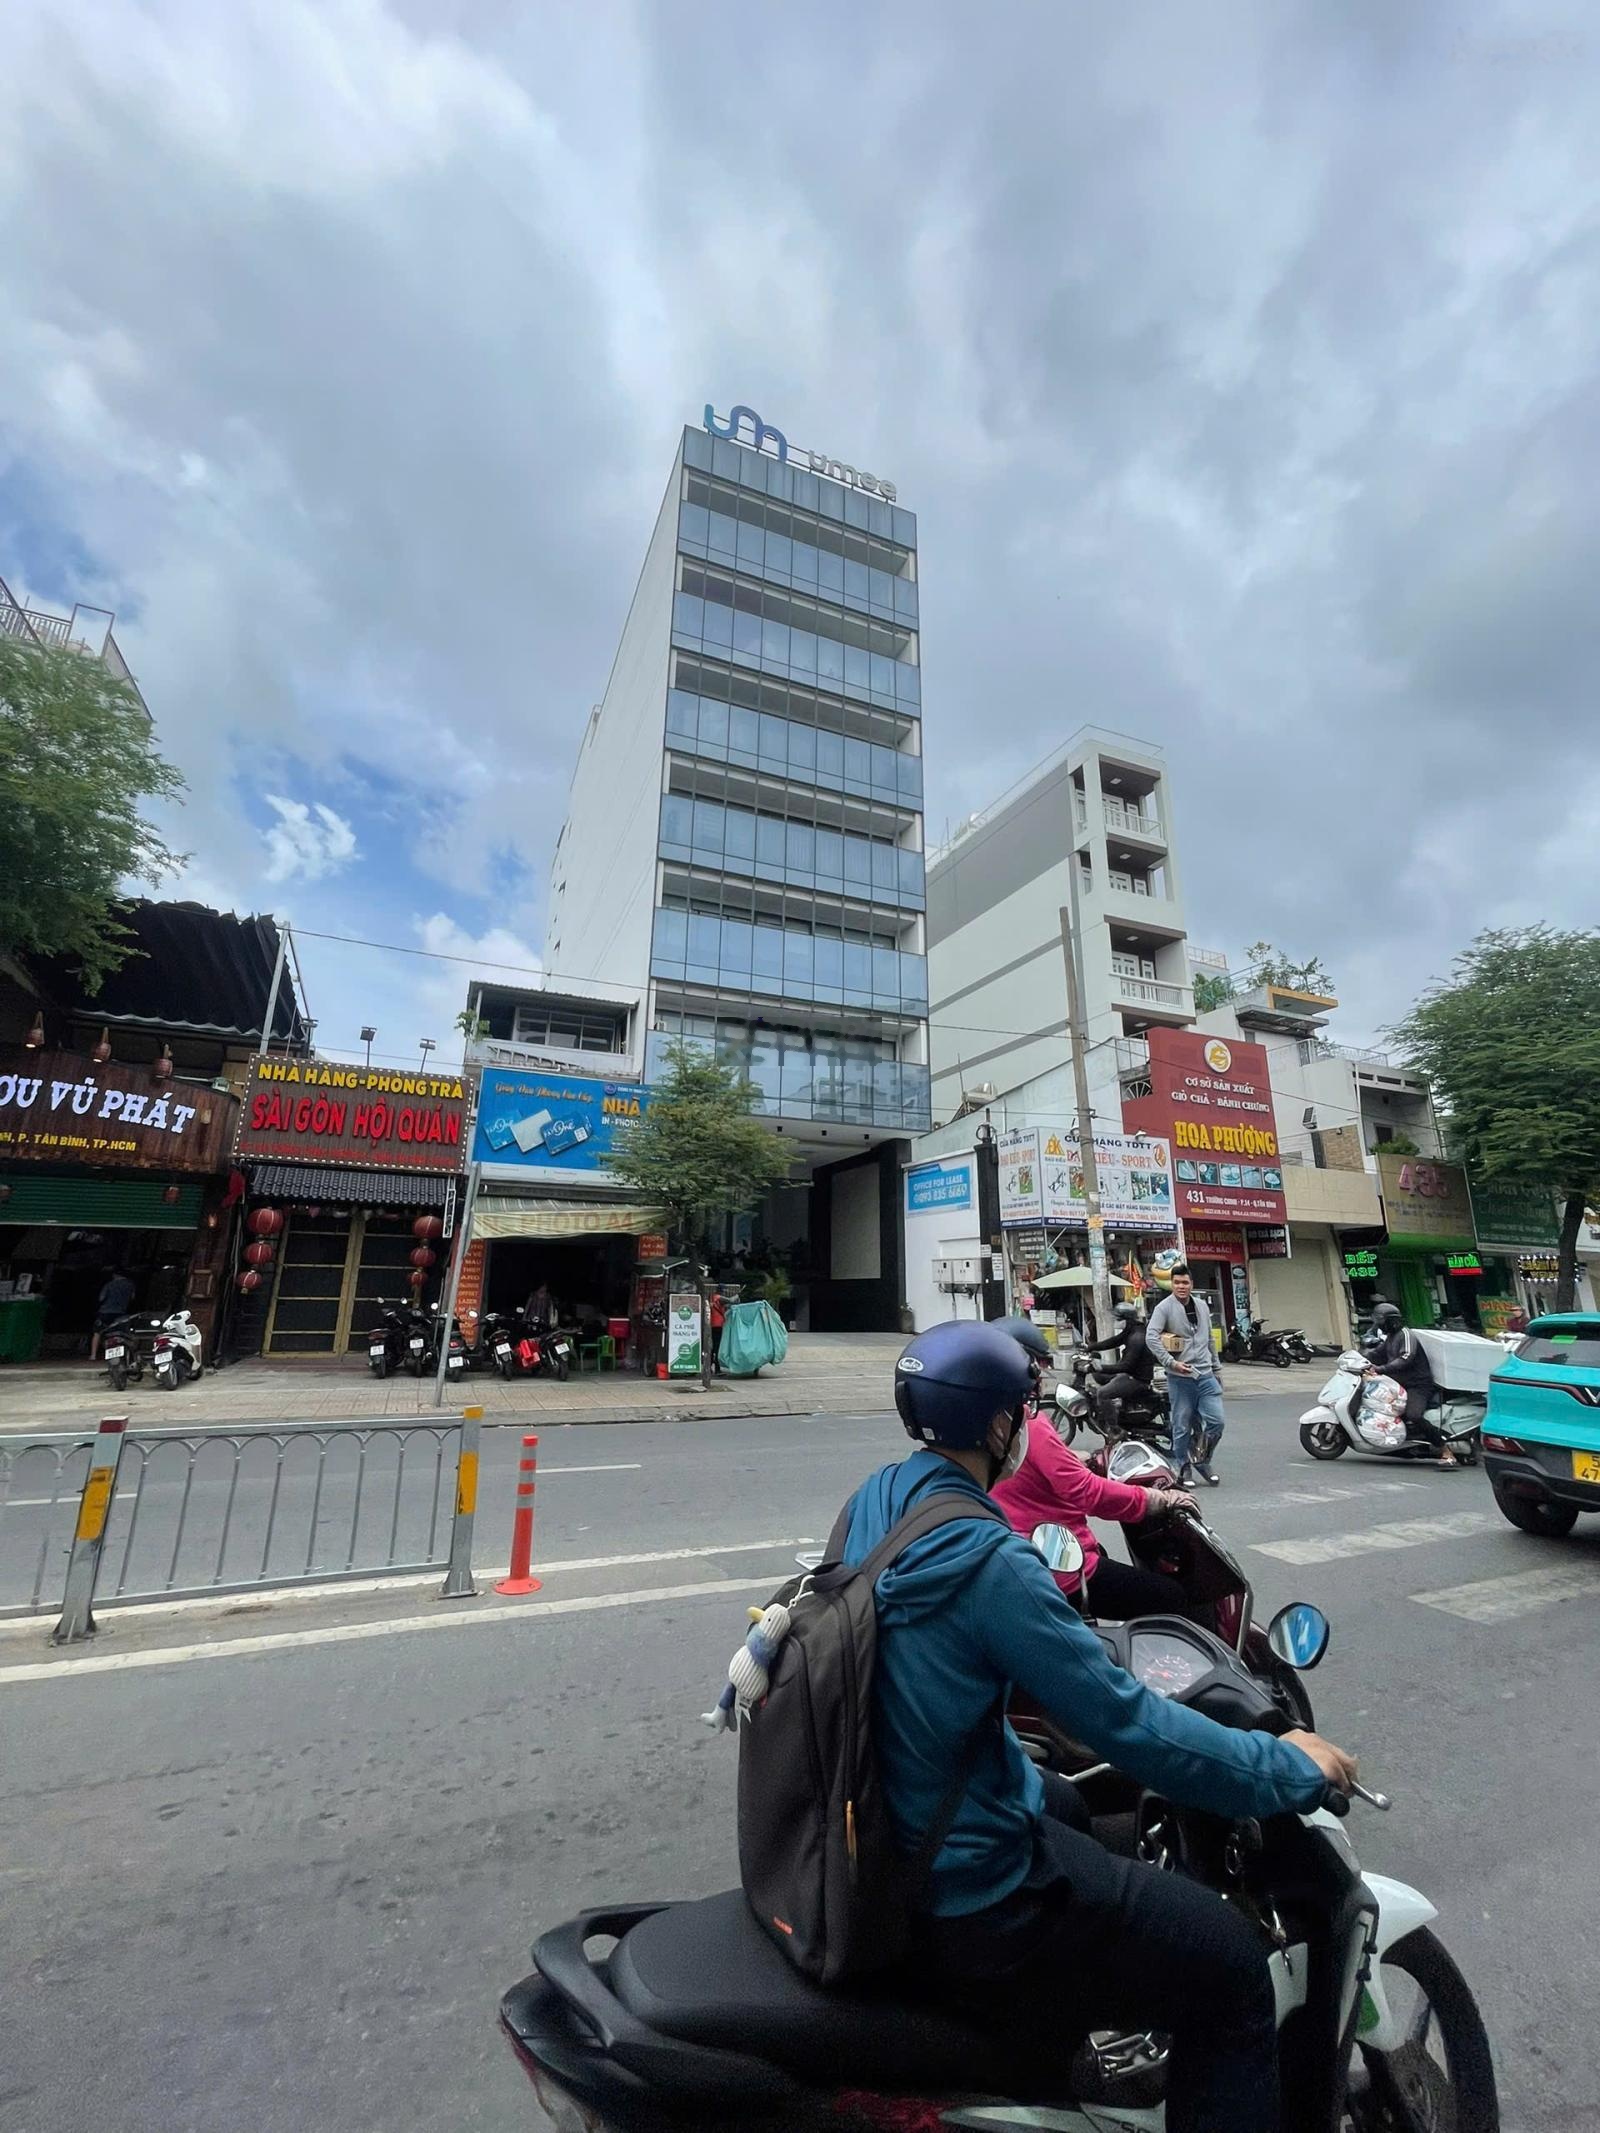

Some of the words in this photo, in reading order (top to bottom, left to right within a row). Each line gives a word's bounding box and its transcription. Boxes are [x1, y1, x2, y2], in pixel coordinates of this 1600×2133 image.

[808, 450, 897, 500] umee
[258, 1062, 300, 1083] NHÀ
[430, 1079, 464, 1099] TRÀ
[51, 1077, 98, 1115] VŨ
[98, 1089, 196, 1134] PHÁT
[1171, 1090, 1187, 1102] GIÒ
[1217, 1096, 1241, 1109] BÁNH
[251, 1087, 294, 1131] SÀI
[293, 1090, 348, 1136] GÒN
[352, 1096, 395, 1148] HỘI
[397, 1103, 462, 1146] QUÁN
[34, 1133, 58, 1146] TÂN
[93, 1138, 136, 1151] TP.HCM
[1125, 1140, 1151, 1150] TDTT
[1175, 1121, 1211, 1150] HOA
[1212, 1123, 1276, 1159] PHƯỢNG
[1122, 1155, 1151, 1169] SPORT
[913, 1181, 932, 1191] OFFICE
[933, 1178, 945, 1187] FOR
[946, 1175, 963, 1183] LEASE
[1186, 1190, 1205, 1203] 431
[1345, 1250, 1377, 1264] BẾP
